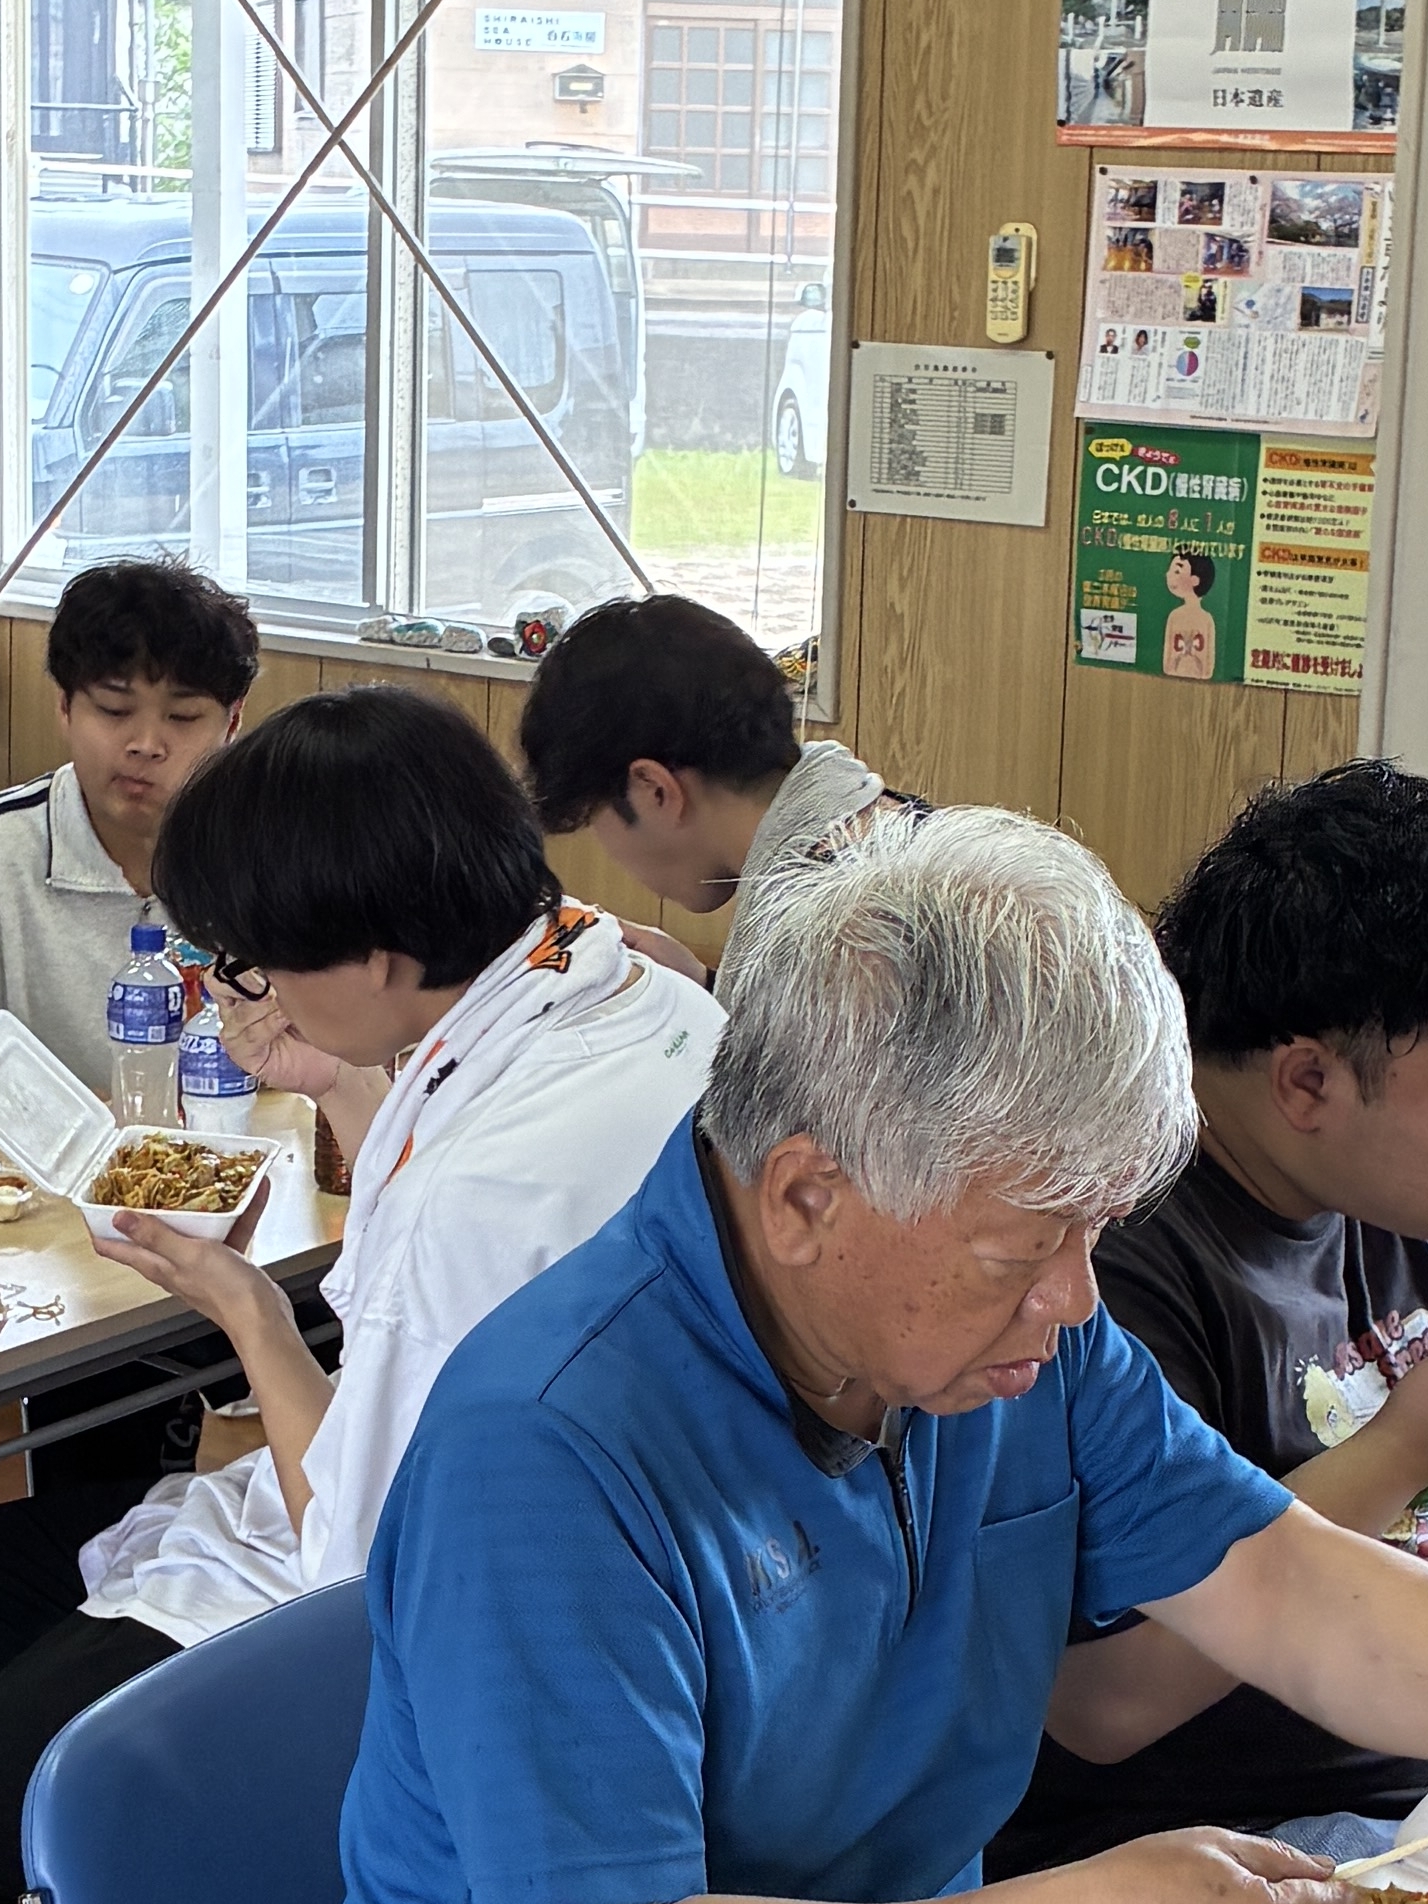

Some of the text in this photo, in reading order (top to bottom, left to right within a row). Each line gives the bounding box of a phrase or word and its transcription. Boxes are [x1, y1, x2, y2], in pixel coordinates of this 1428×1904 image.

[483, 26, 510, 35] SEA
[1212, 88, 1285, 108] 日本遺産
